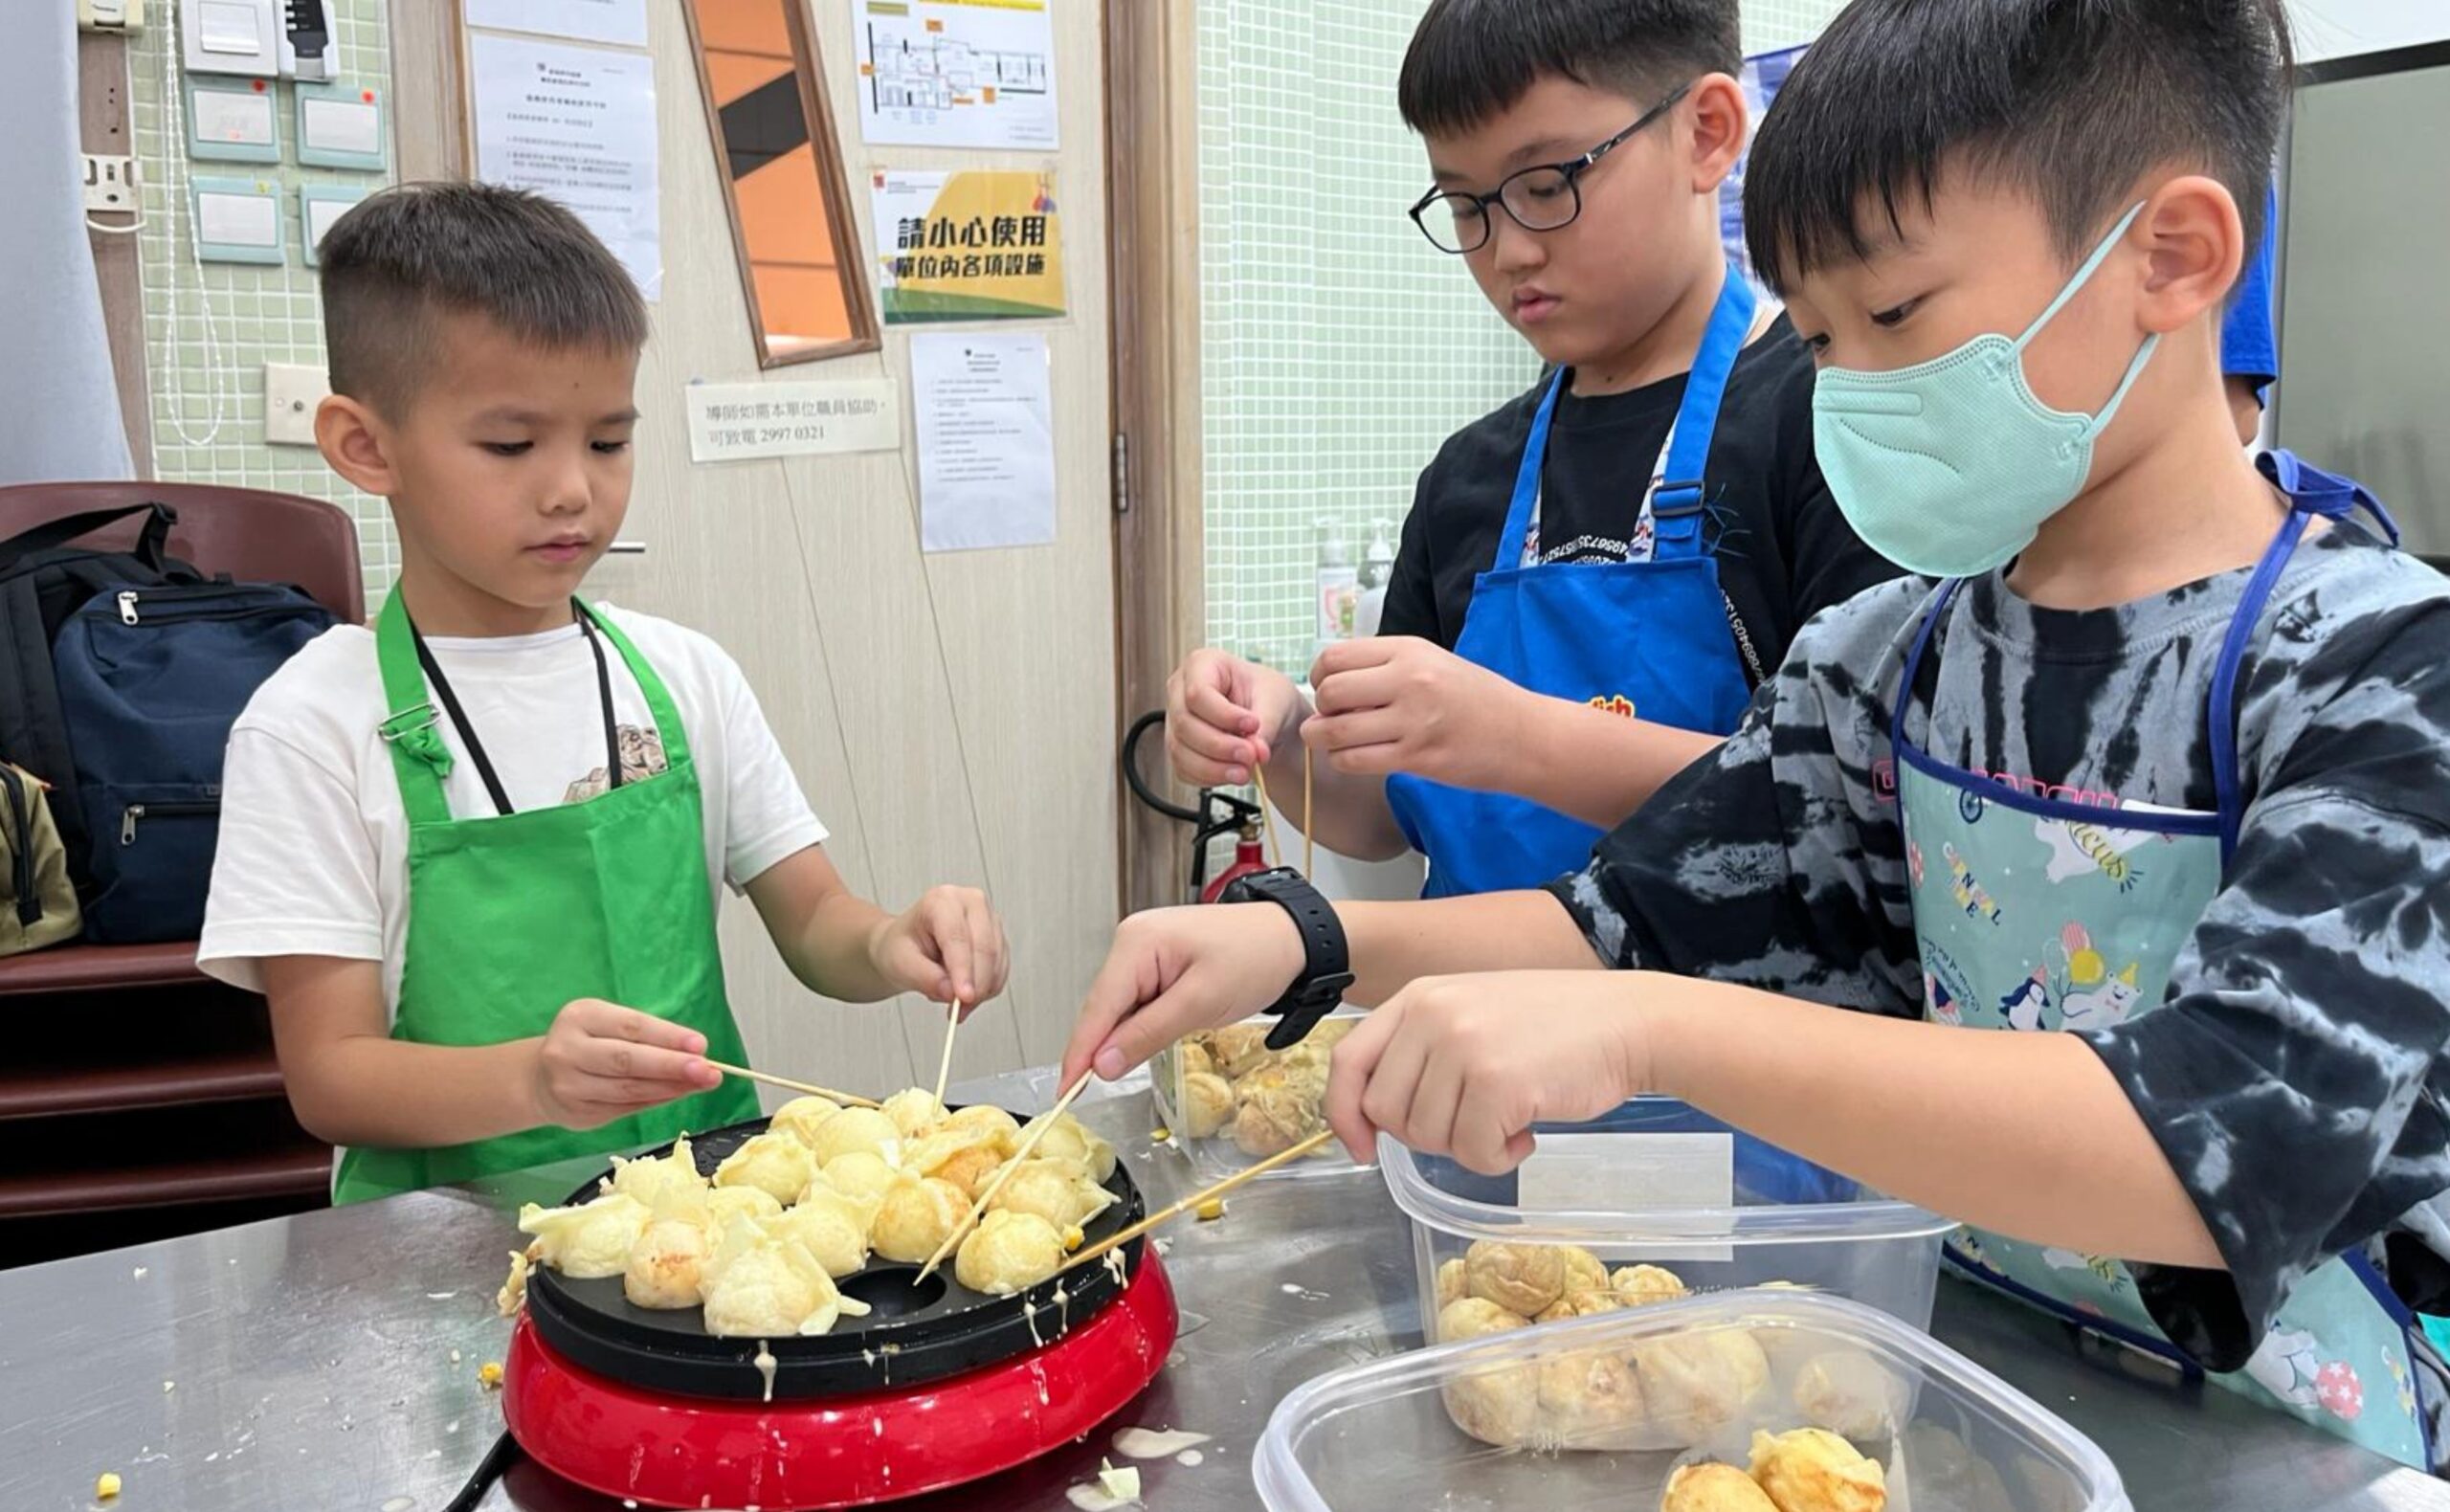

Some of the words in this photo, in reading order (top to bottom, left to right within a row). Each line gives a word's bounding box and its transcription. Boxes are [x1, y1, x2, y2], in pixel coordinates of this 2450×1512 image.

[898, 216, 1046, 250] 請小心使用
[896, 254, 1045, 278] 單位內各項設施
[708, 428, 757, 446] 可致電
[761, 426, 791, 443] 2997
[794, 425, 824, 441] 0321
